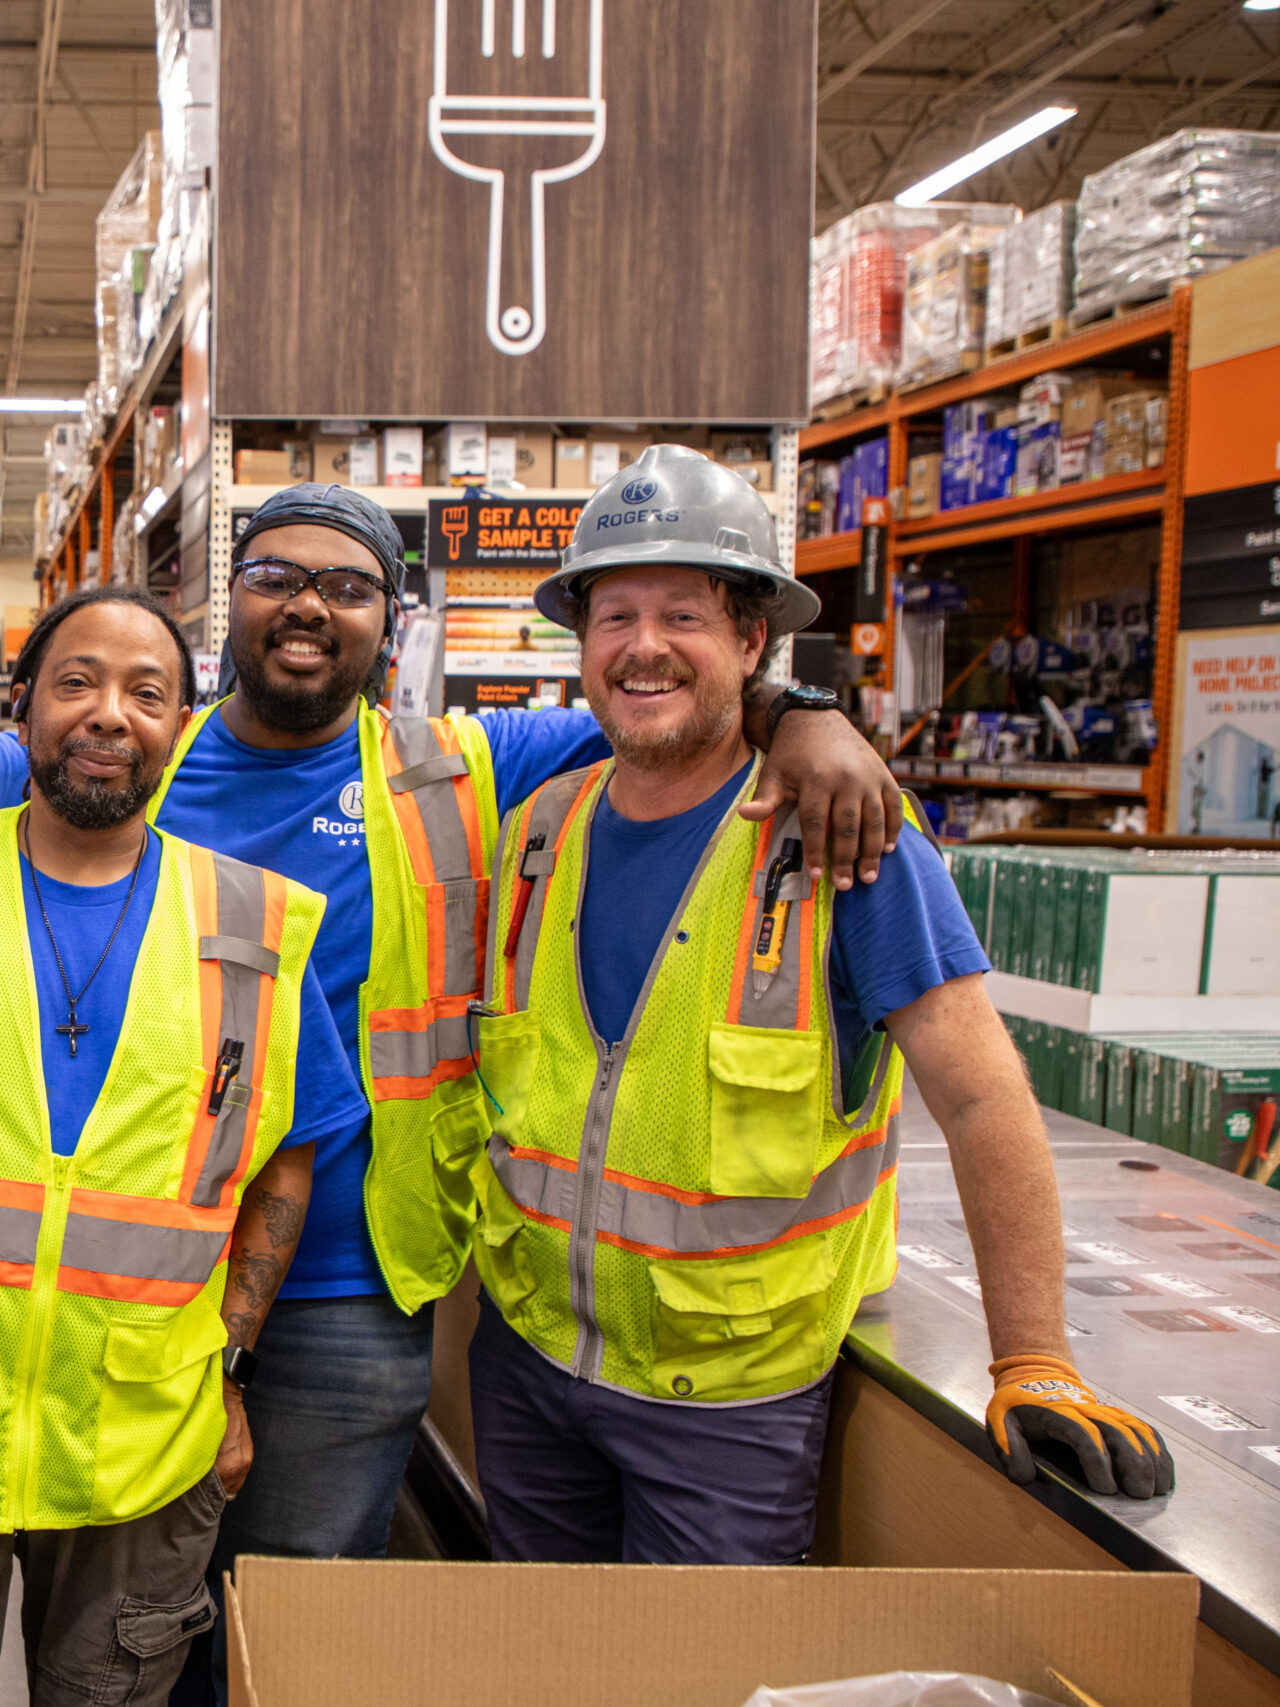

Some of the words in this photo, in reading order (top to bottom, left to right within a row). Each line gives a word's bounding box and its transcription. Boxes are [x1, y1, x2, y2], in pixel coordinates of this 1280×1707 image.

[478, 507, 514, 527] GET
[517, 507, 532, 527] A
[596, 509, 680, 531] ROGERS
[477, 528, 553, 548] SAMPLE
[312, 816, 366, 836] ROGE
